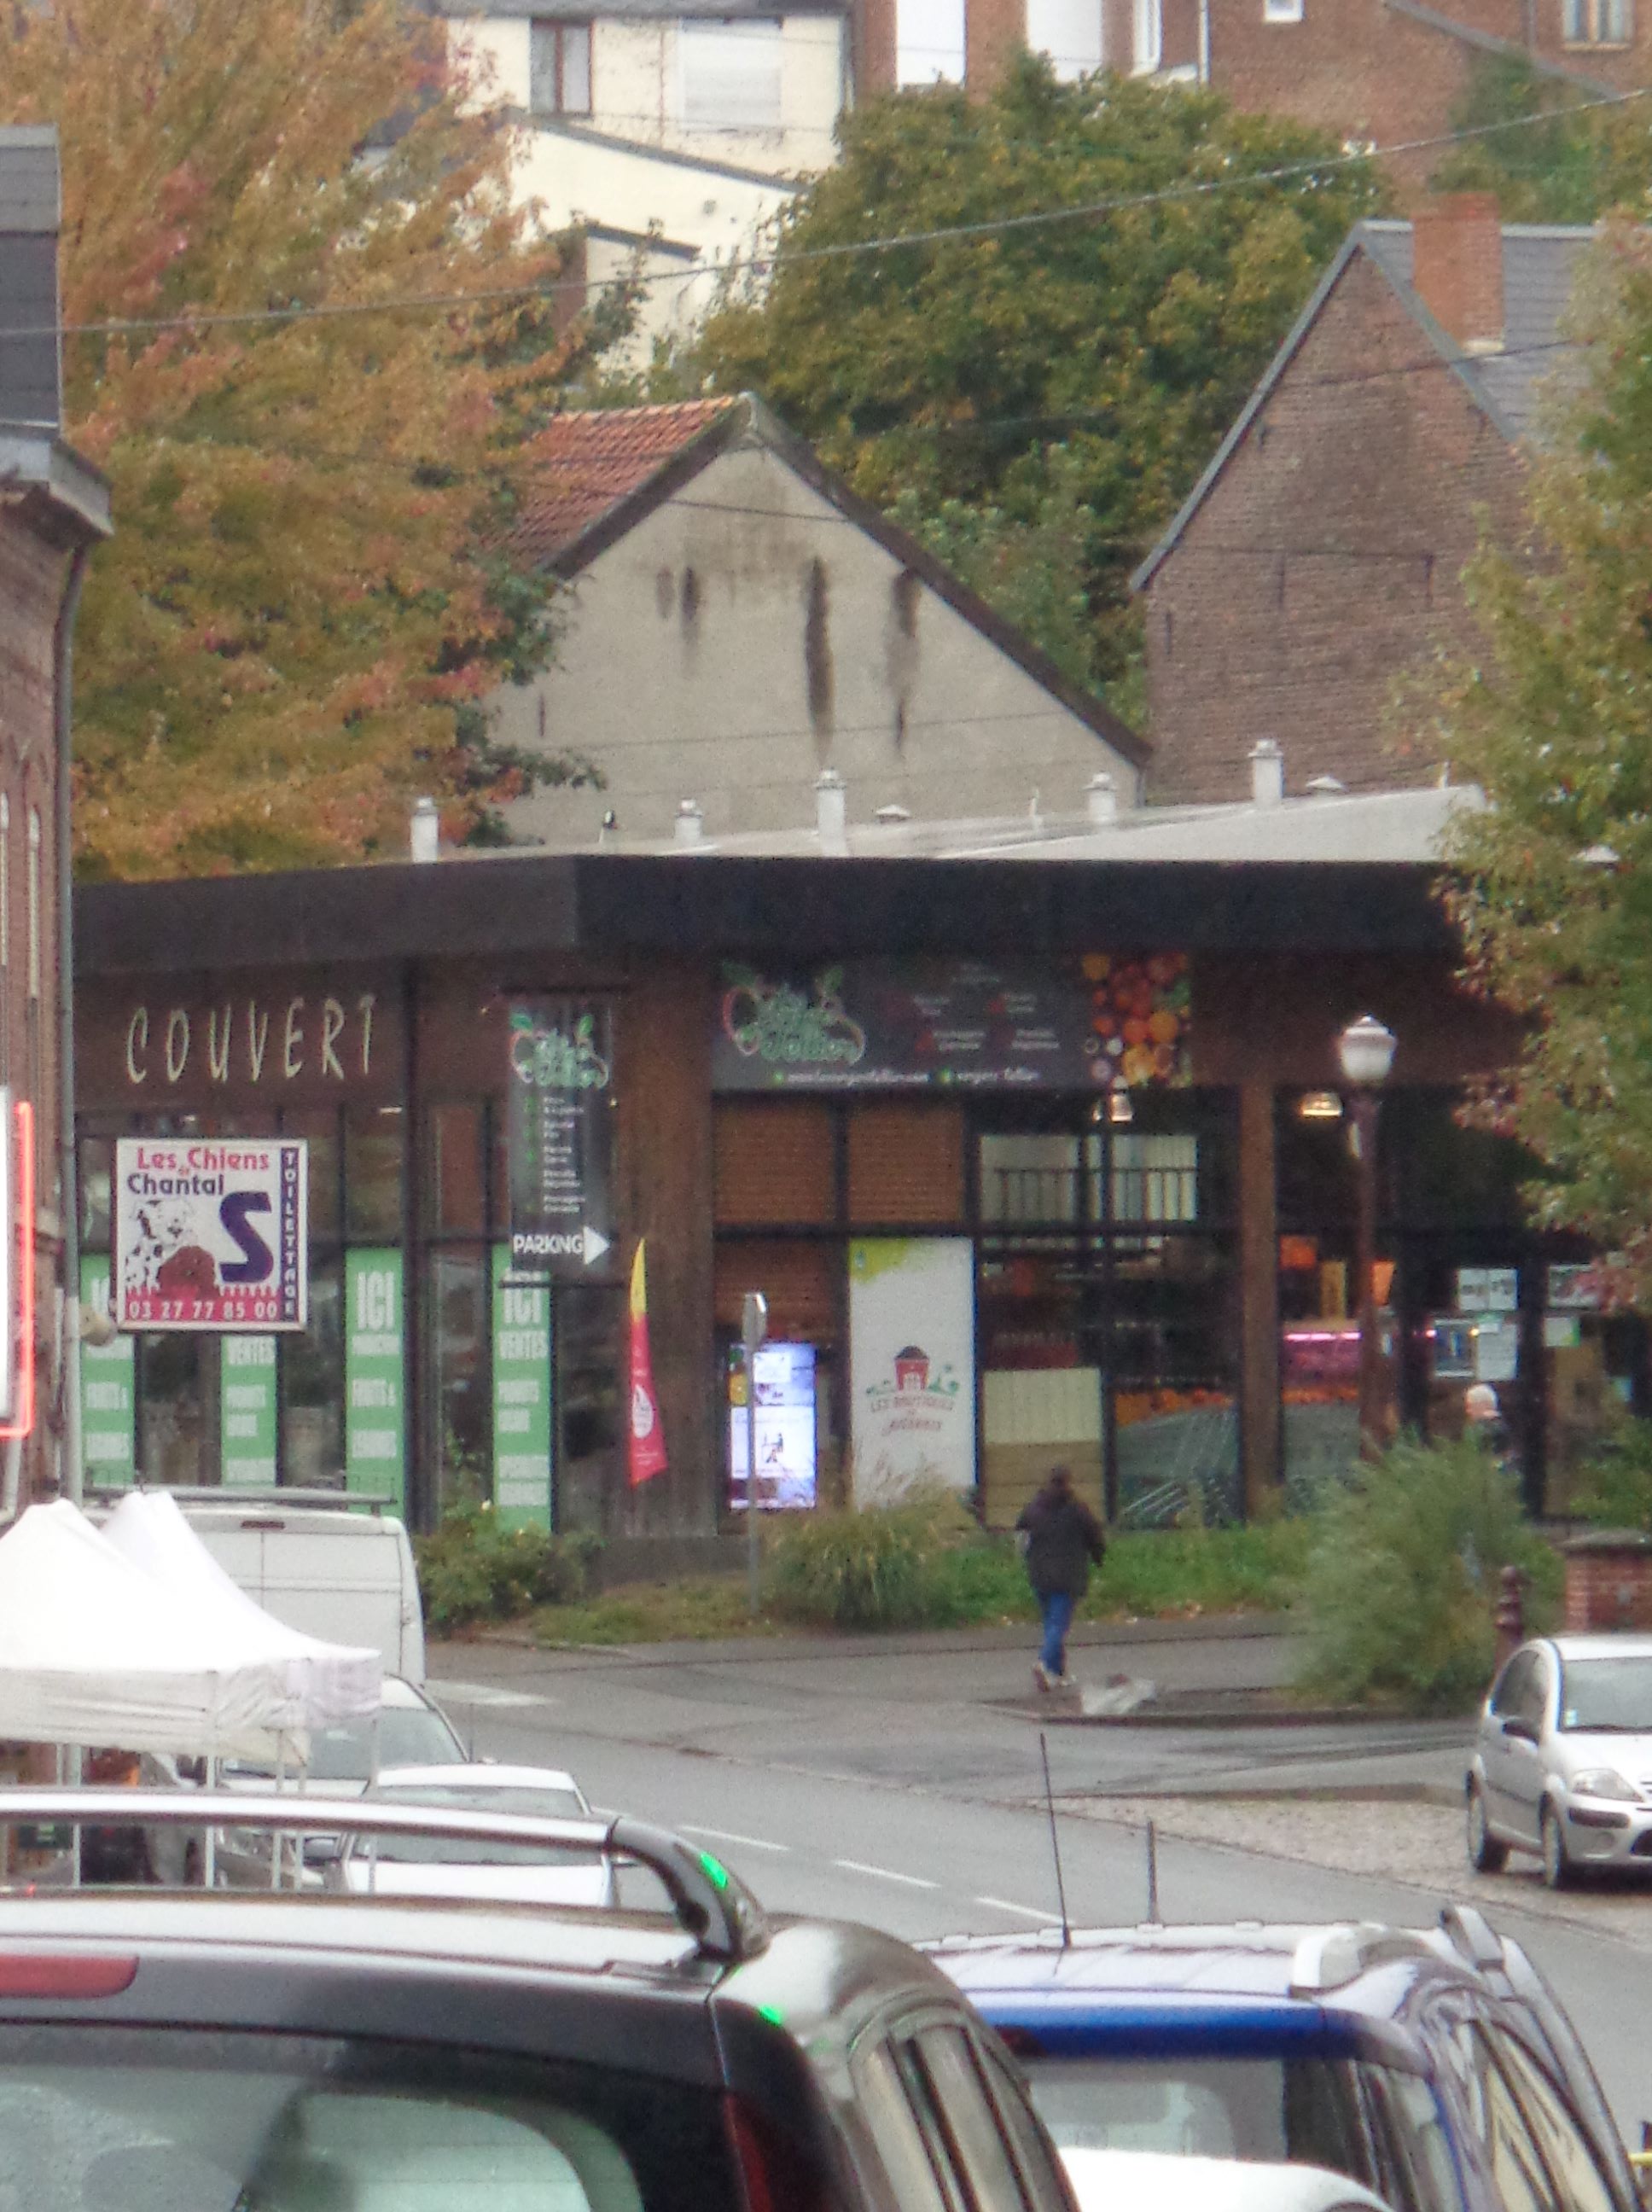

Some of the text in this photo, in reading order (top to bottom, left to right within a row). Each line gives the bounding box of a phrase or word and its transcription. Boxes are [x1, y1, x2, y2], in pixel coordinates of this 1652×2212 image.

[127, 994, 375, 1083] COUVERT
[137, 1146, 270, 1170] Les Chiens
[127, 1173, 224, 1195] Chantal
[283, 1152, 297, 1315] TOILETTAGE
[514, 1234, 584, 1254] PARKING
[129, 1301, 277, 1318] 03 27 77 85 00
[357, 1271, 395, 1330] ICI
